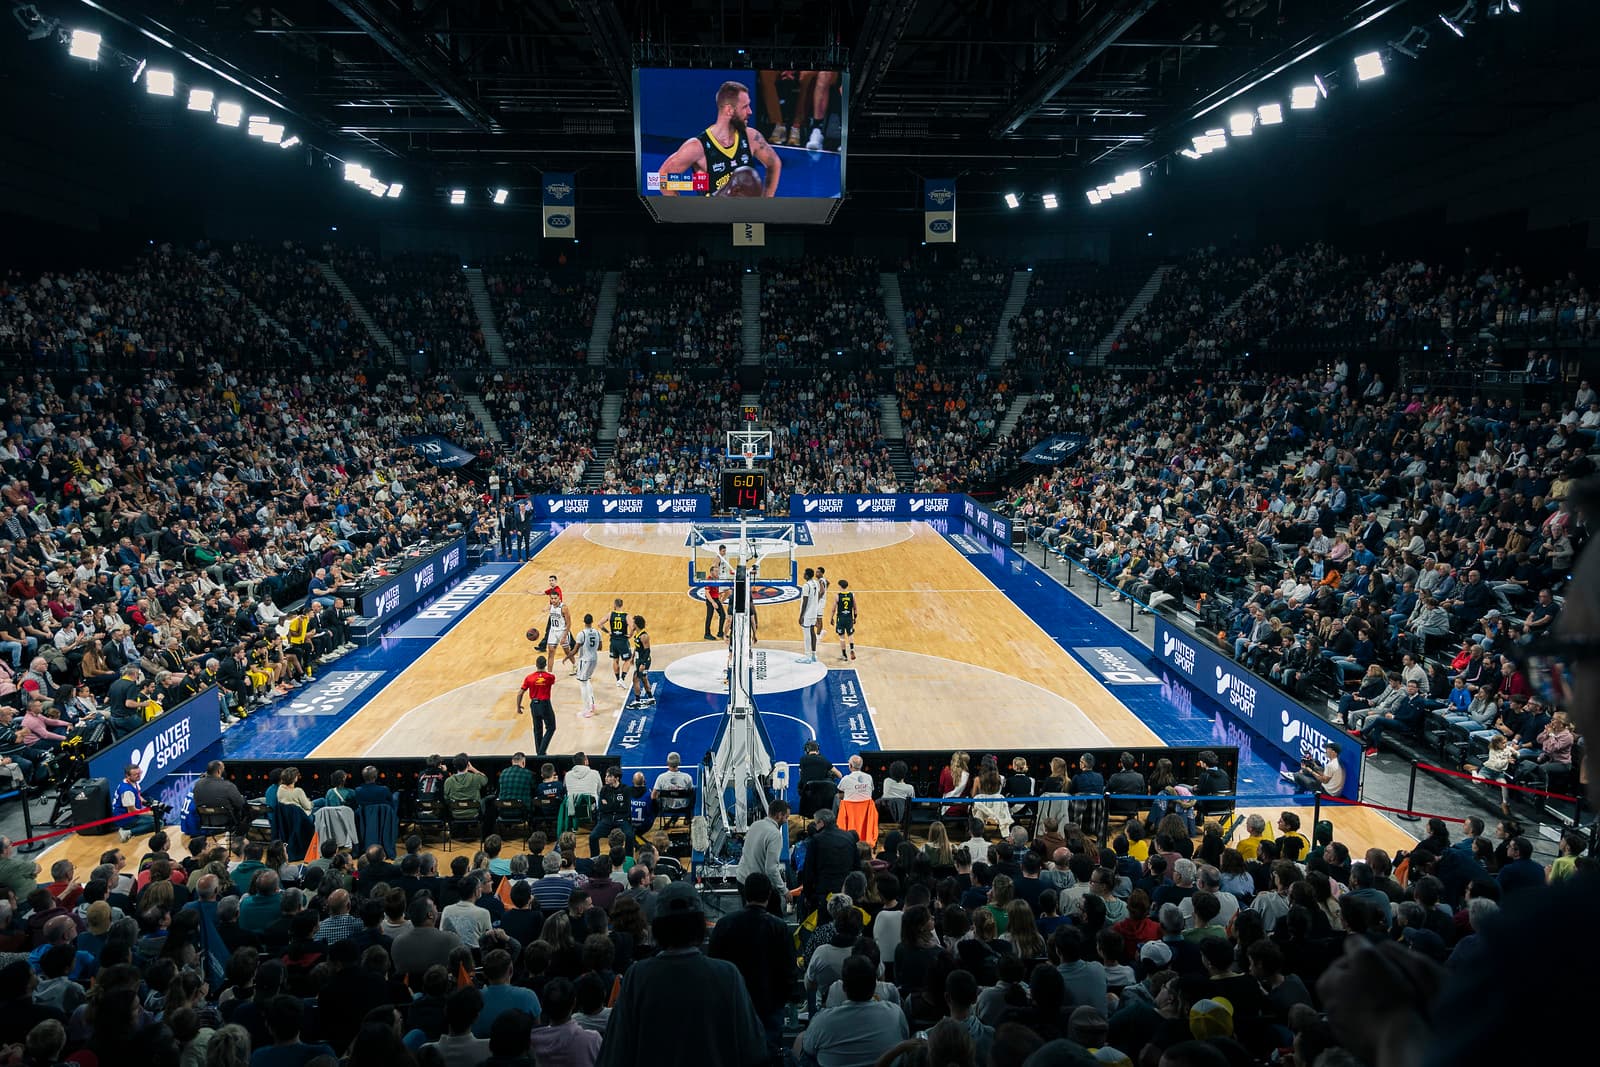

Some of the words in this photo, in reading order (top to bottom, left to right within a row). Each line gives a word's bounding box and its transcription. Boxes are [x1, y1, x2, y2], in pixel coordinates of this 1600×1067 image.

[734, 475, 763, 487] 6:07
[738, 489, 757, 508] 14
[924, 498, 950, 506] INTER
[421, 563, 434, 578] INTER
[385, 584, 400, 599] INTER
[422, 574, 434, 589] SPORT
[385, 596, 400, 613] SPORT
[416, 574, 501, 619] POITIERS
[614, 620, 623, 630] 10
[589, 637, 595, 647] 5
[1175, 638, 1195, 663] INTER
[1174, 651, 1194, 675] SPORT
[319, 672, 367, 697] dalkia
[1231, 675, 1256, 704] INTER
[1229, 691, 1255, 718] SPORT
[155, 718, 190, 752] INTER
[156, 734, 190, 769] SPORT
[1300, 739, 1329, 767] SPOR
